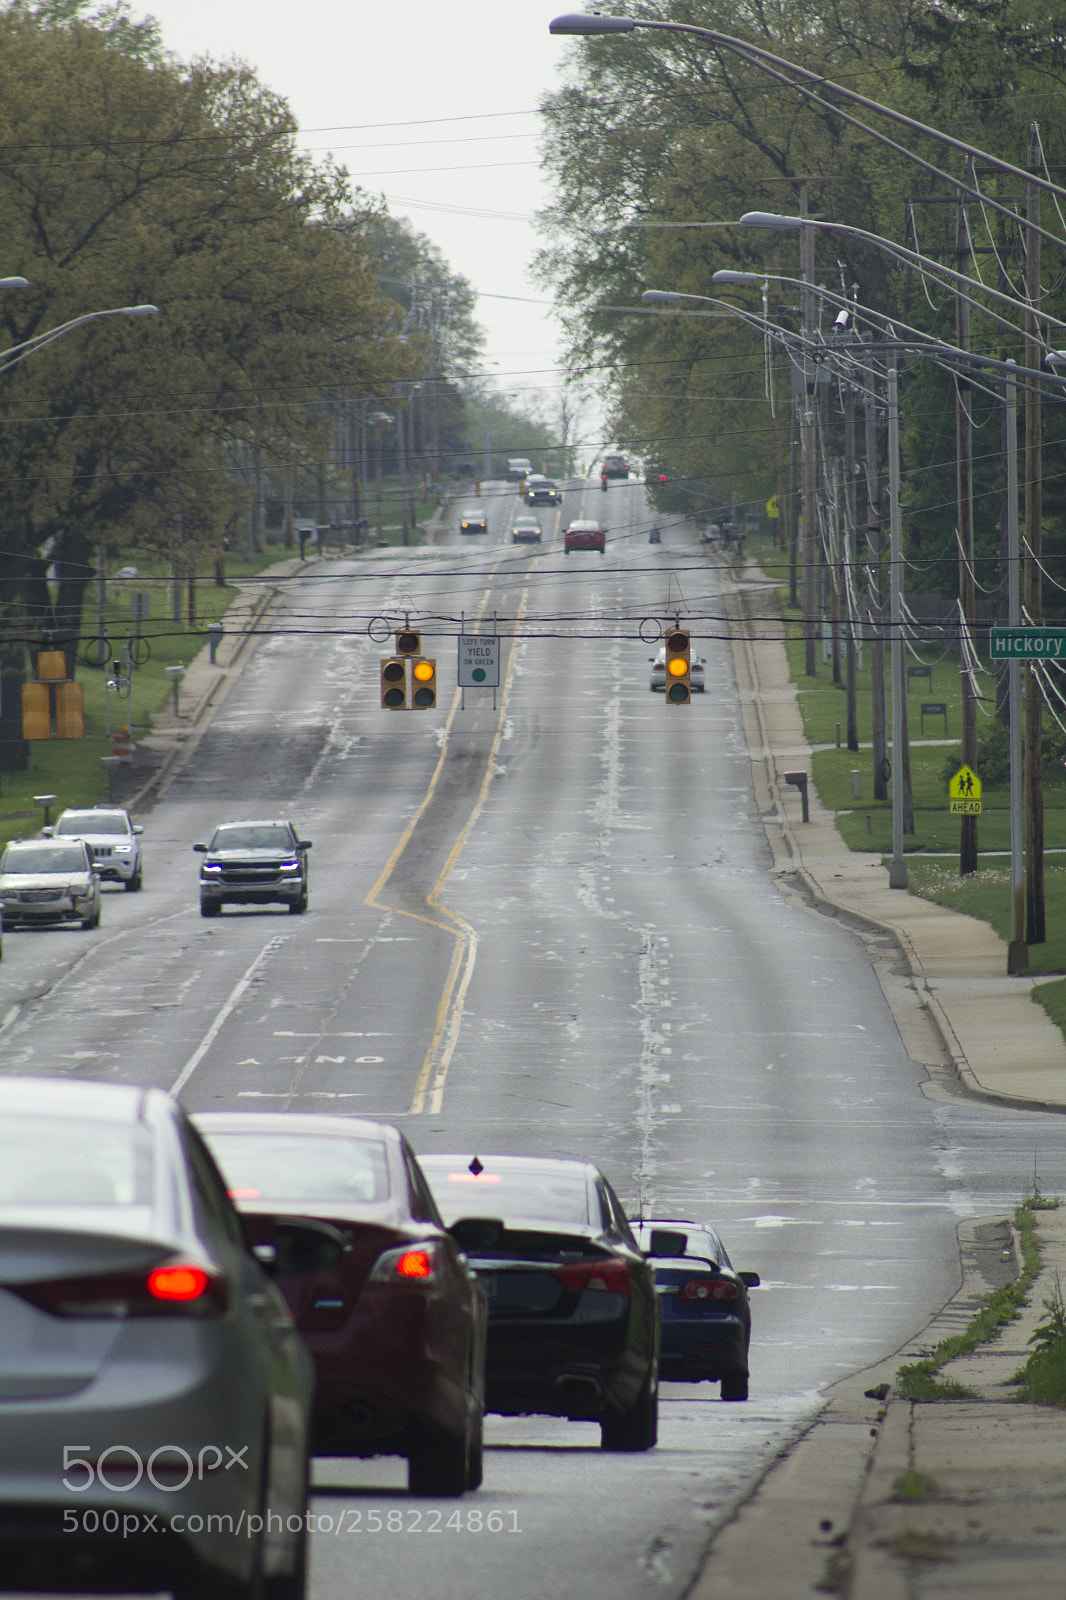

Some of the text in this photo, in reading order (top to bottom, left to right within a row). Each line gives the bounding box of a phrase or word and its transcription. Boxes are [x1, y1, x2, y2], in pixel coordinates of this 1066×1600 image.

[462, 638, 496, 646] LEFT TURN
[996, 634, 1063, 656] Hickory
[467, 647, 491, 657] YIELD
[463, 658, 495, 666] ON GREEN
[951, 802, 981, 813] AHEAD
[236, 1055, 386, 1065] ONLY
